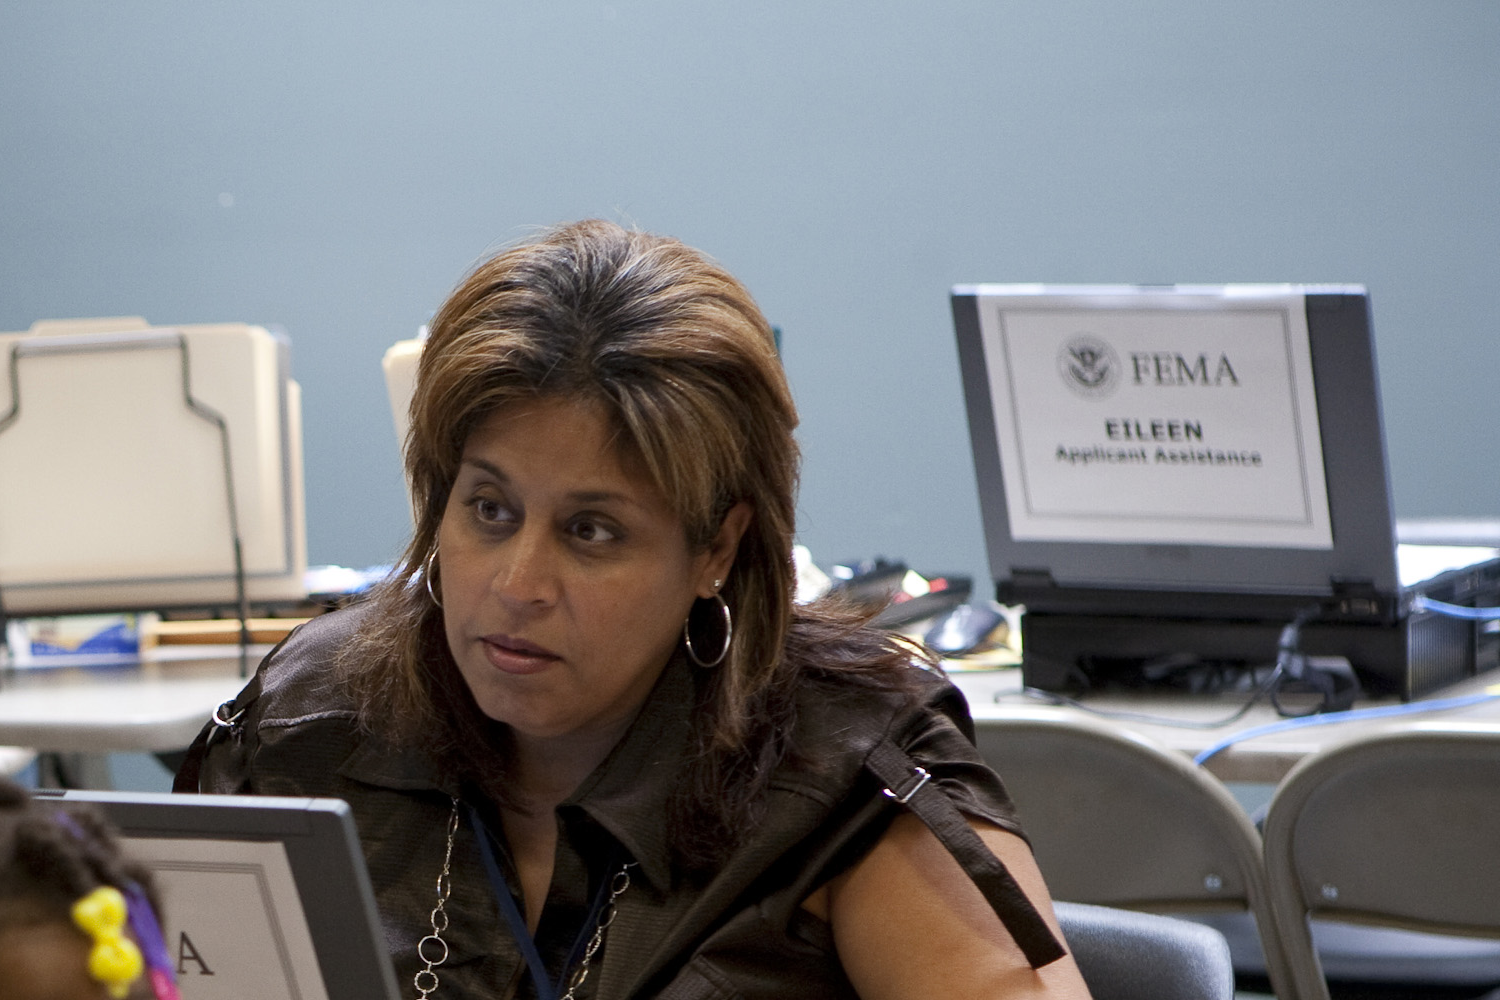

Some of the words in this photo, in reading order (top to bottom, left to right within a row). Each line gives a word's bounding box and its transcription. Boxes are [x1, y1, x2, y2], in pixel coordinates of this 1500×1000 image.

[1129, 350, 1240, 387] FEMA
[1105, 417, 1204, 442] EILEEN
[1056, 444, 1149, 465] Applicant
[1155, 447, 1264, 468] Assistance
